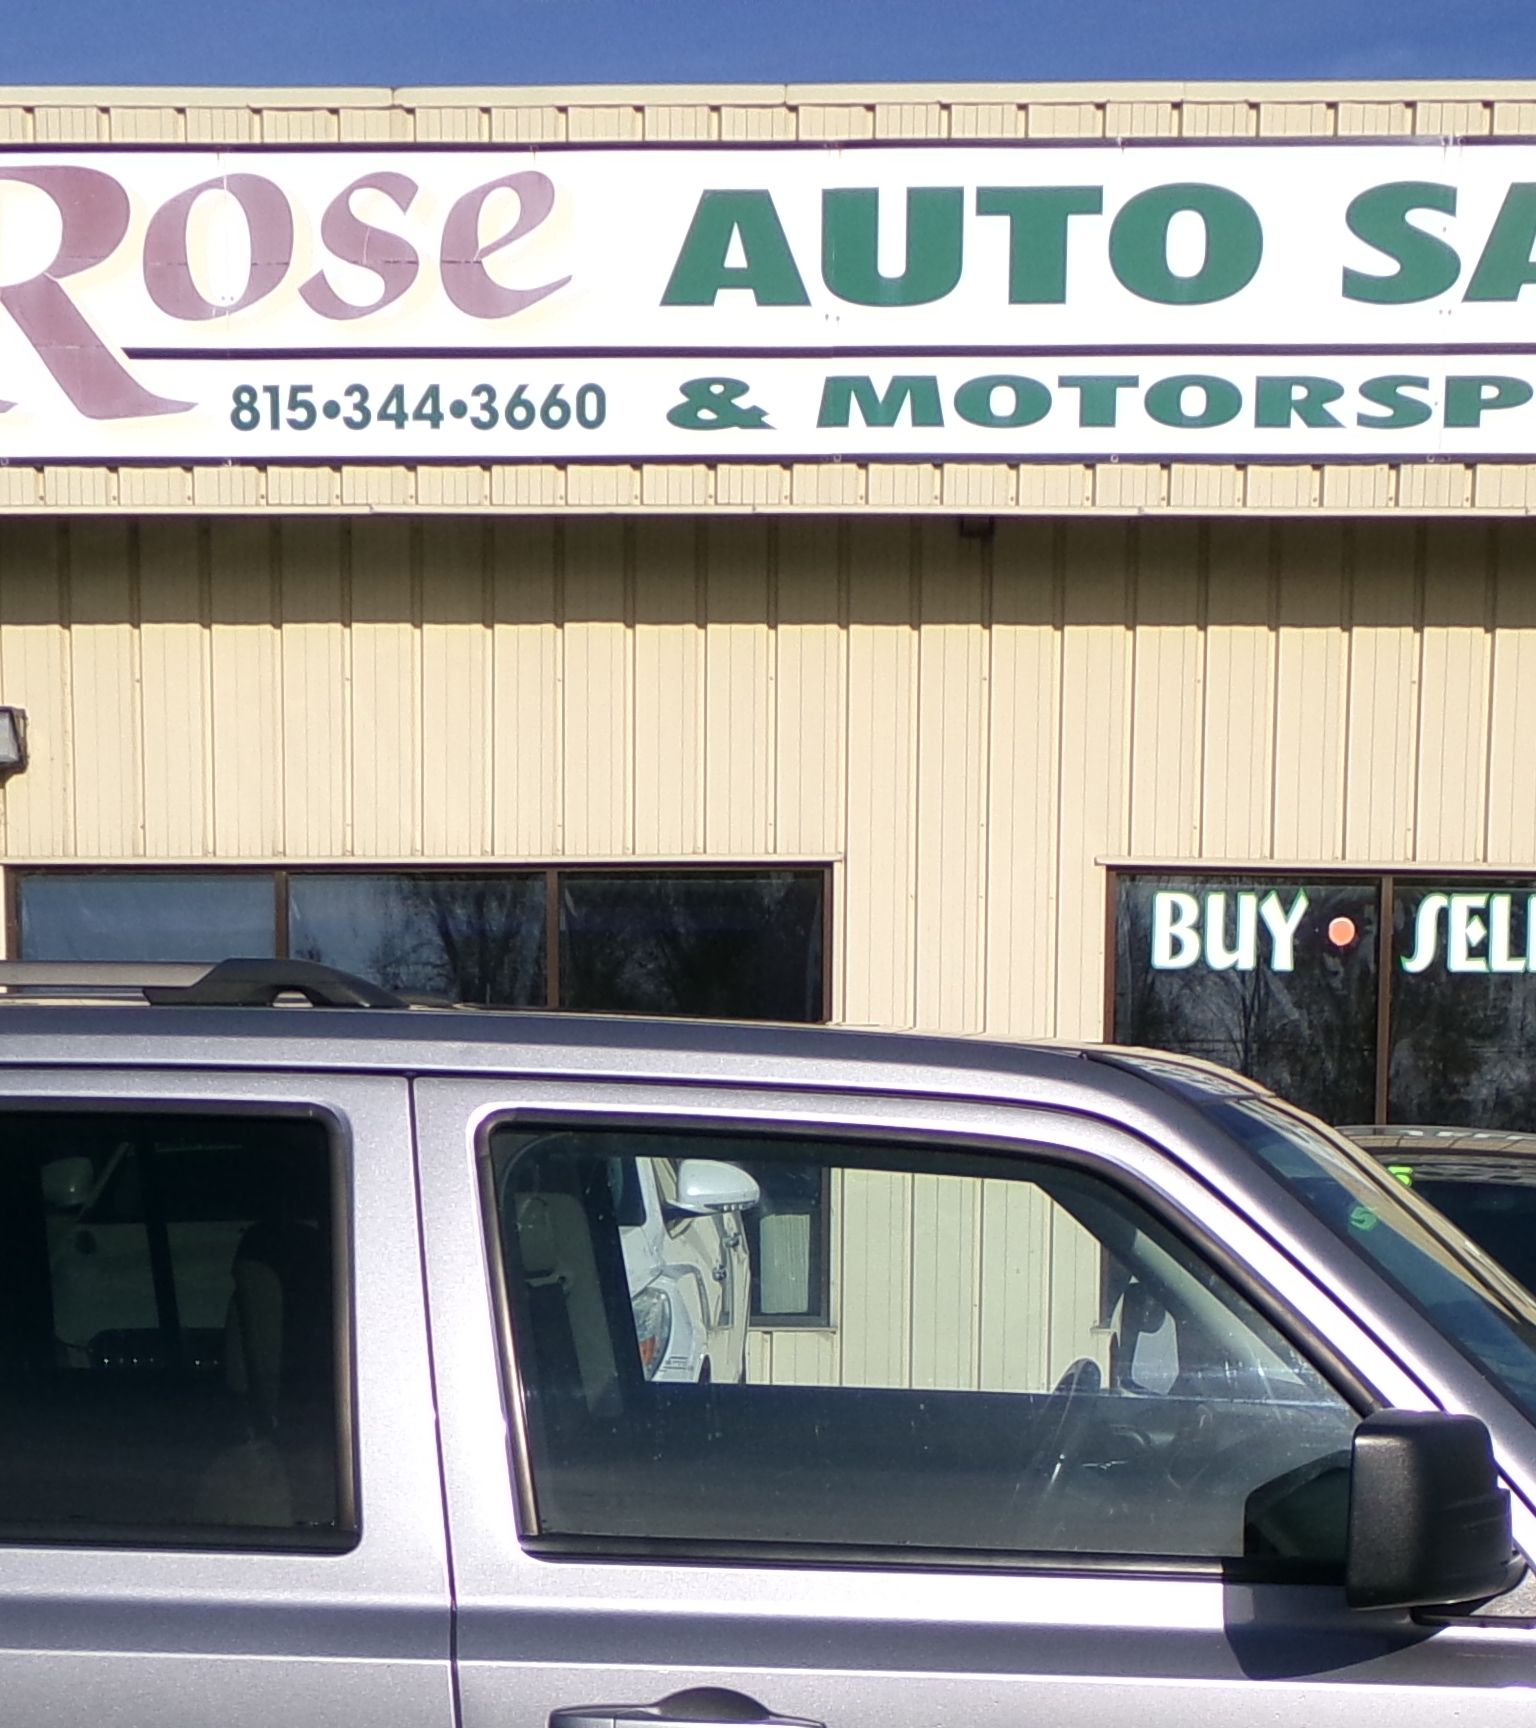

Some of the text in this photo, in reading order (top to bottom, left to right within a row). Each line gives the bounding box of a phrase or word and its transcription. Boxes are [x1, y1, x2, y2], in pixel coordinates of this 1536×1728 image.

[659, 183, 1263, 306] AUTO
[666, 377, 776, 430] &
[1151, 888, 1309, 972] BUY
